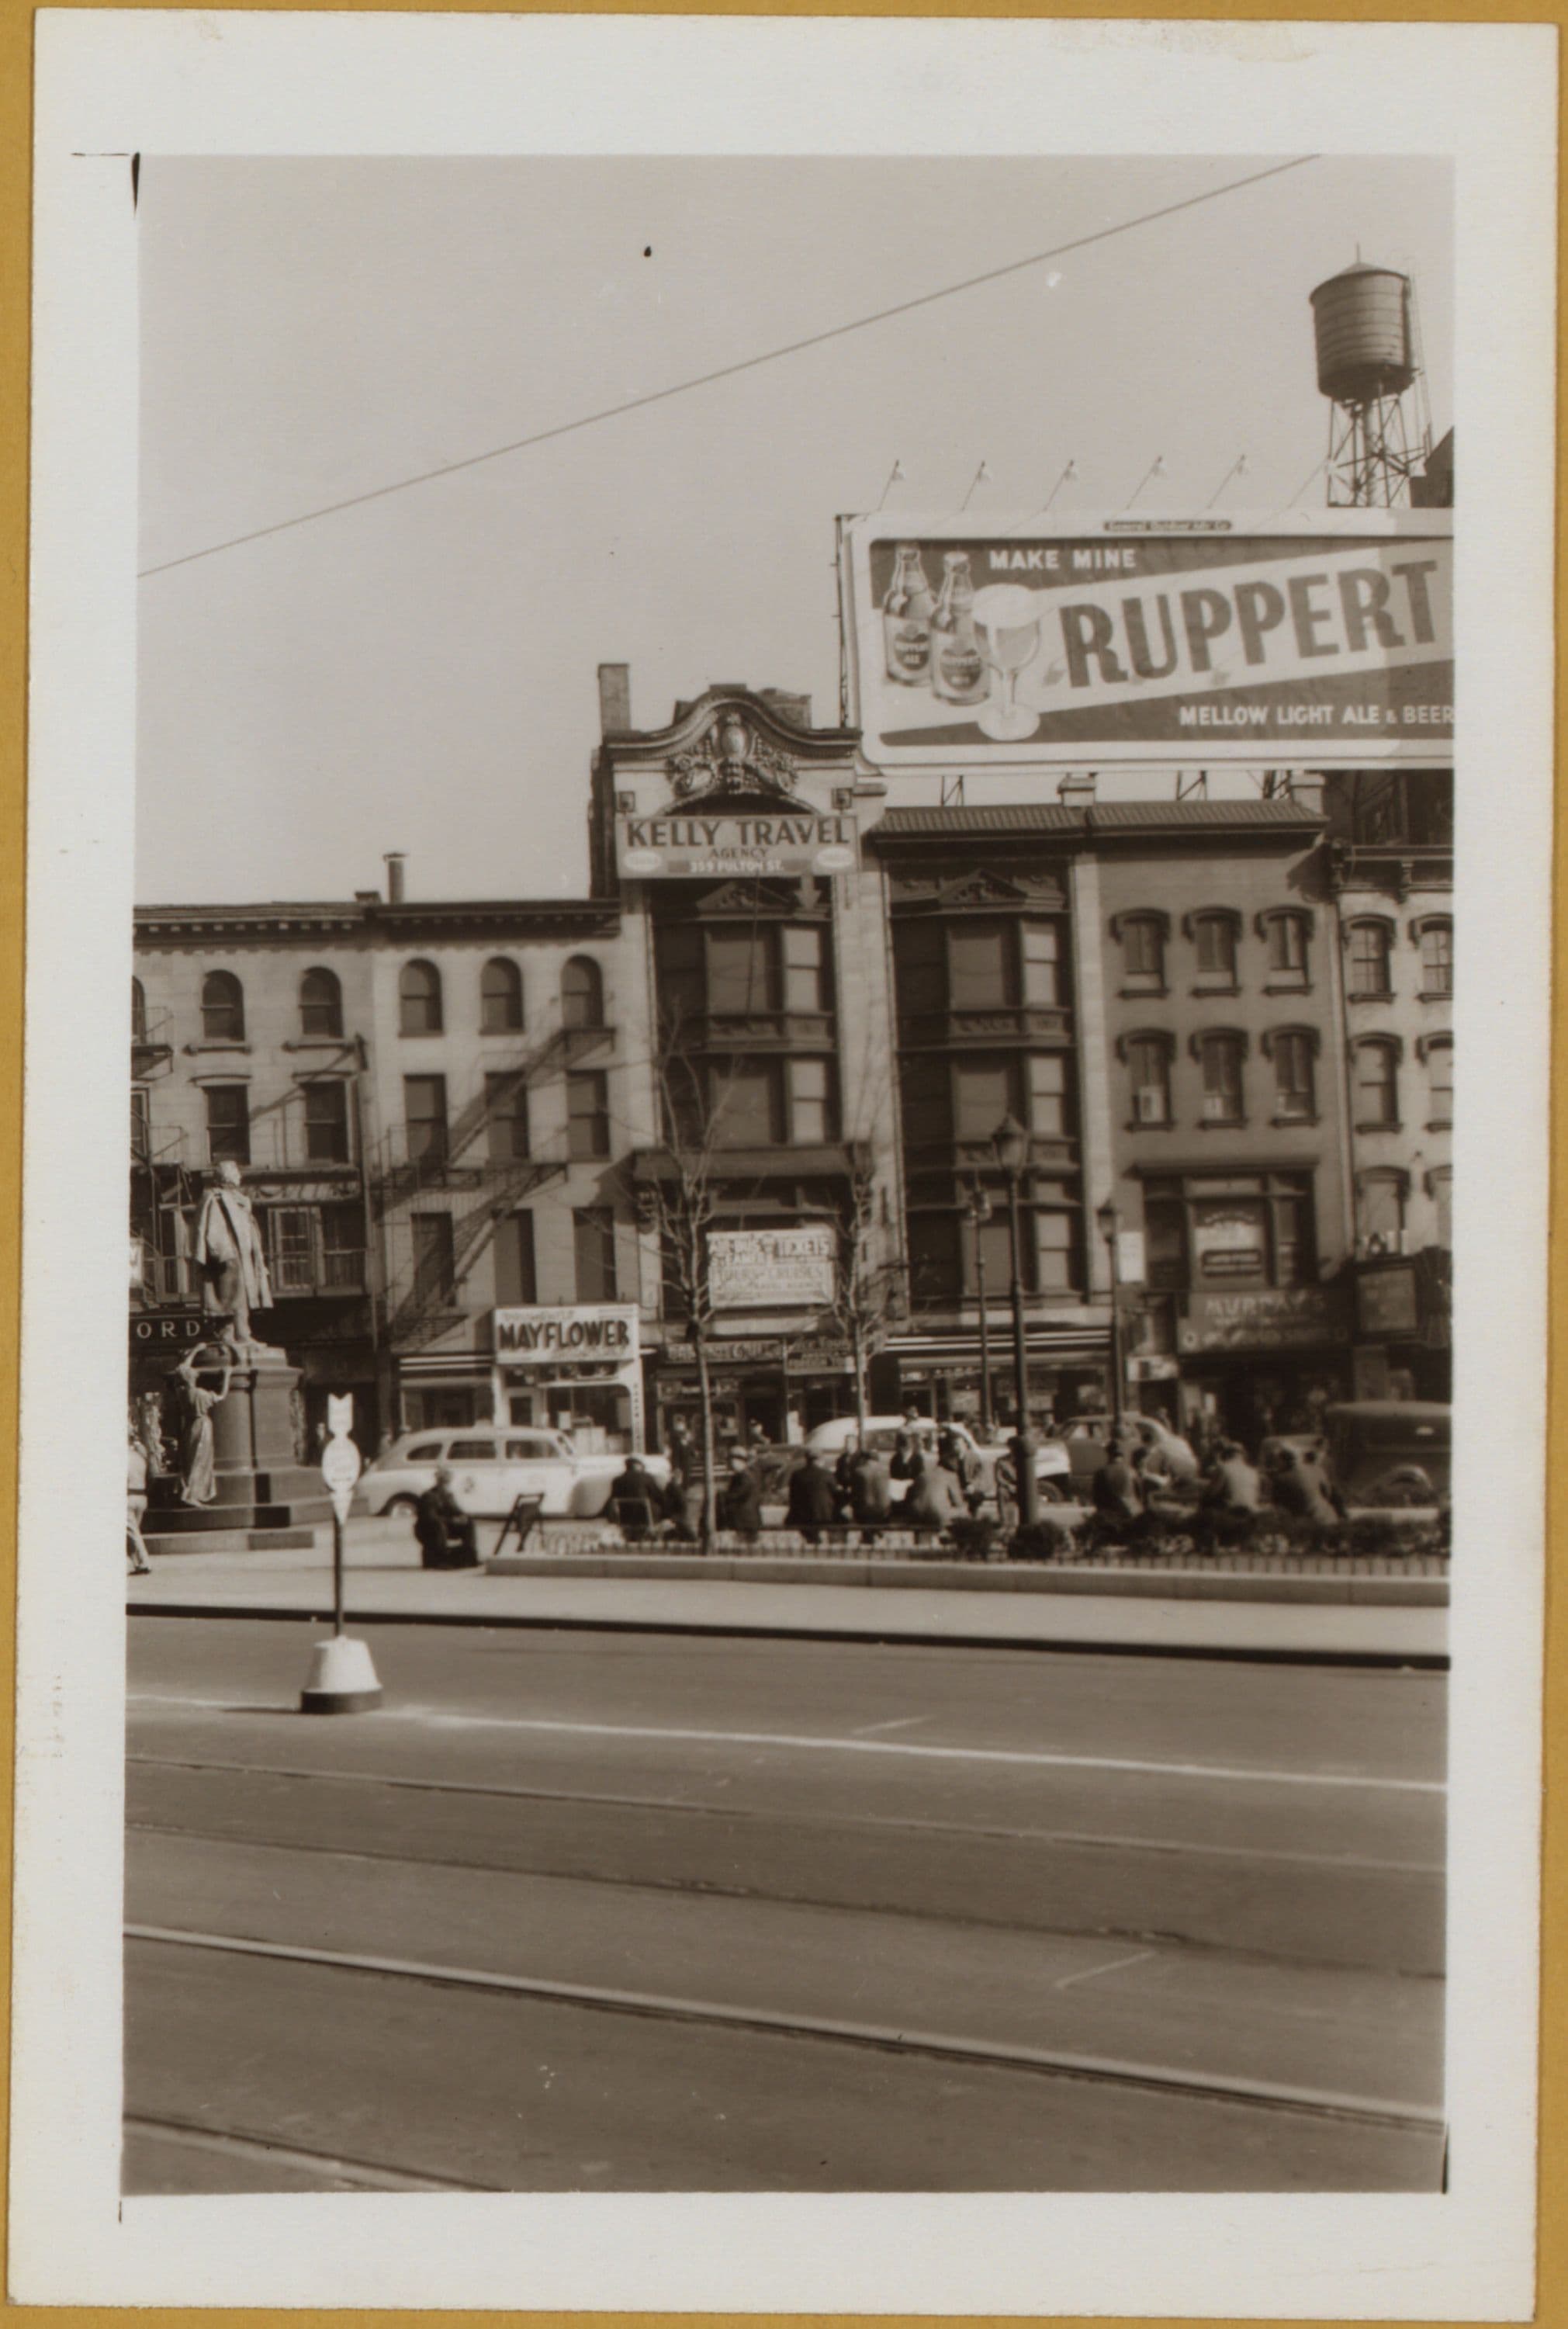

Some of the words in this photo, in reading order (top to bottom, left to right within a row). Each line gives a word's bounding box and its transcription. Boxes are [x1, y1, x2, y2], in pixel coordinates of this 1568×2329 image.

[989, 549, 1059, 569] MAKE
[1073, 549, 1137, 568] MINE
[1058, 560, 1437, 688] RUPPERT
[1179, 705, 1268, 725] MELLOW
[1277, 705, 1334, 724] LIGHT
[1342, 705, 1379, 724] ALE
[626, 820, 721, 847] KELLY
[736, 817, 850, 845] TRAVEL
[709, 848, 769, 858] AGENCY
[718, 861, 763, 873] FULTON
[137, 1320, 201, 1339] ORD
[499, 1319, 629, 1350] MAYFLOWER
